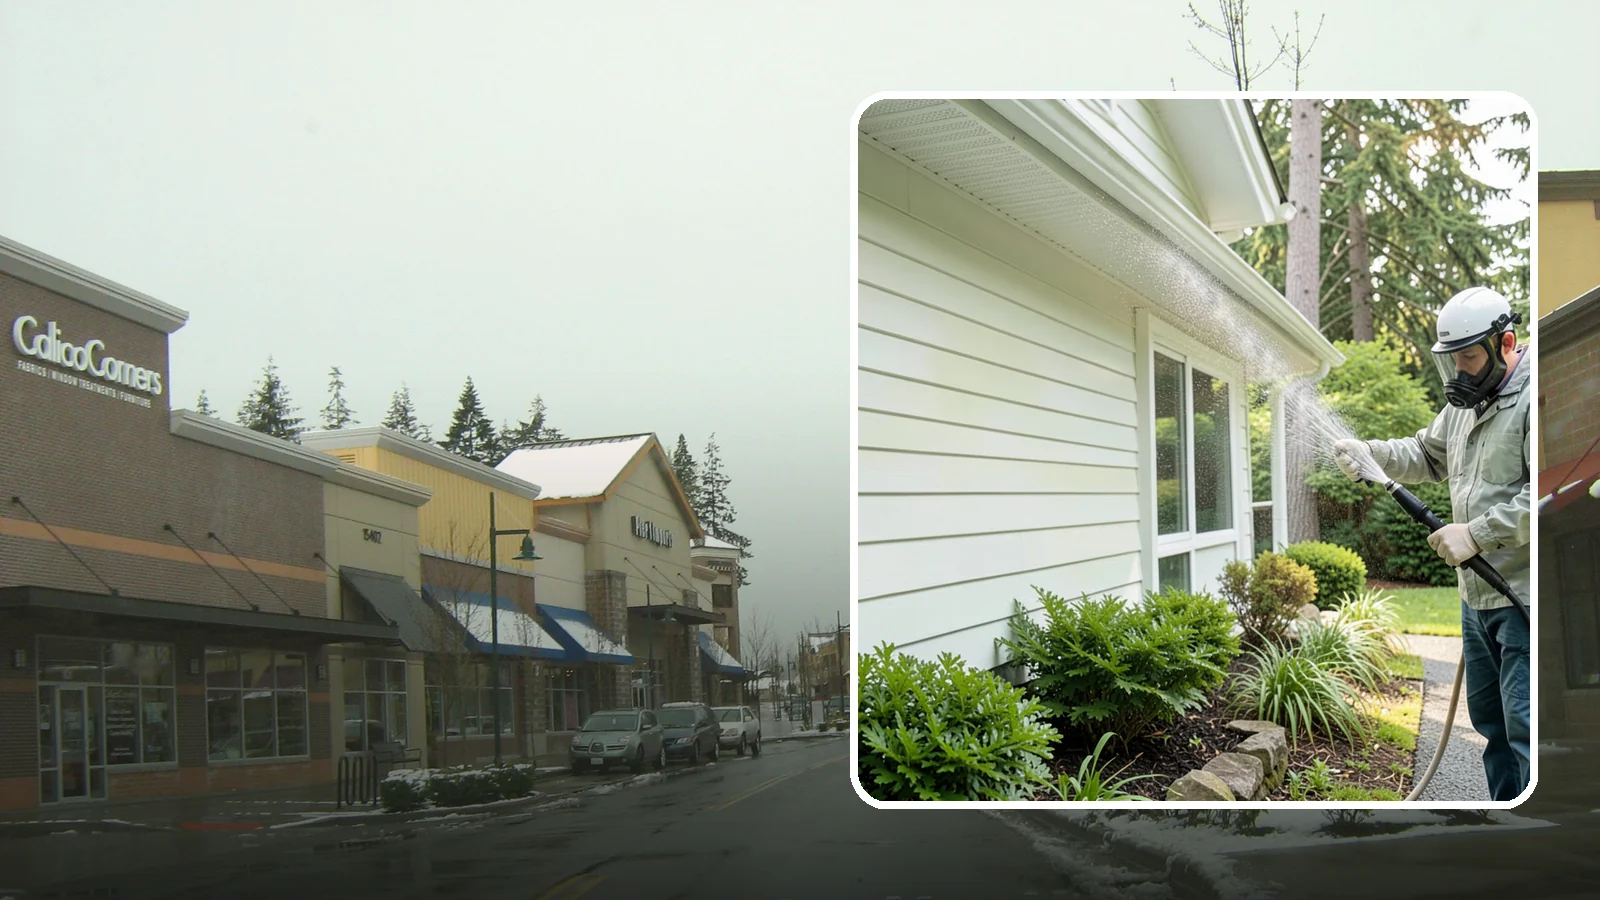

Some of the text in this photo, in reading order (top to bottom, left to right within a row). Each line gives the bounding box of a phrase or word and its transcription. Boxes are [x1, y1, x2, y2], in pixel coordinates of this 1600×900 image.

[17, 360, 47, 377] FABRICS
[51, 370, 78, 387] WINDOW
[78, 379, 117, 398] TREATMENTS
